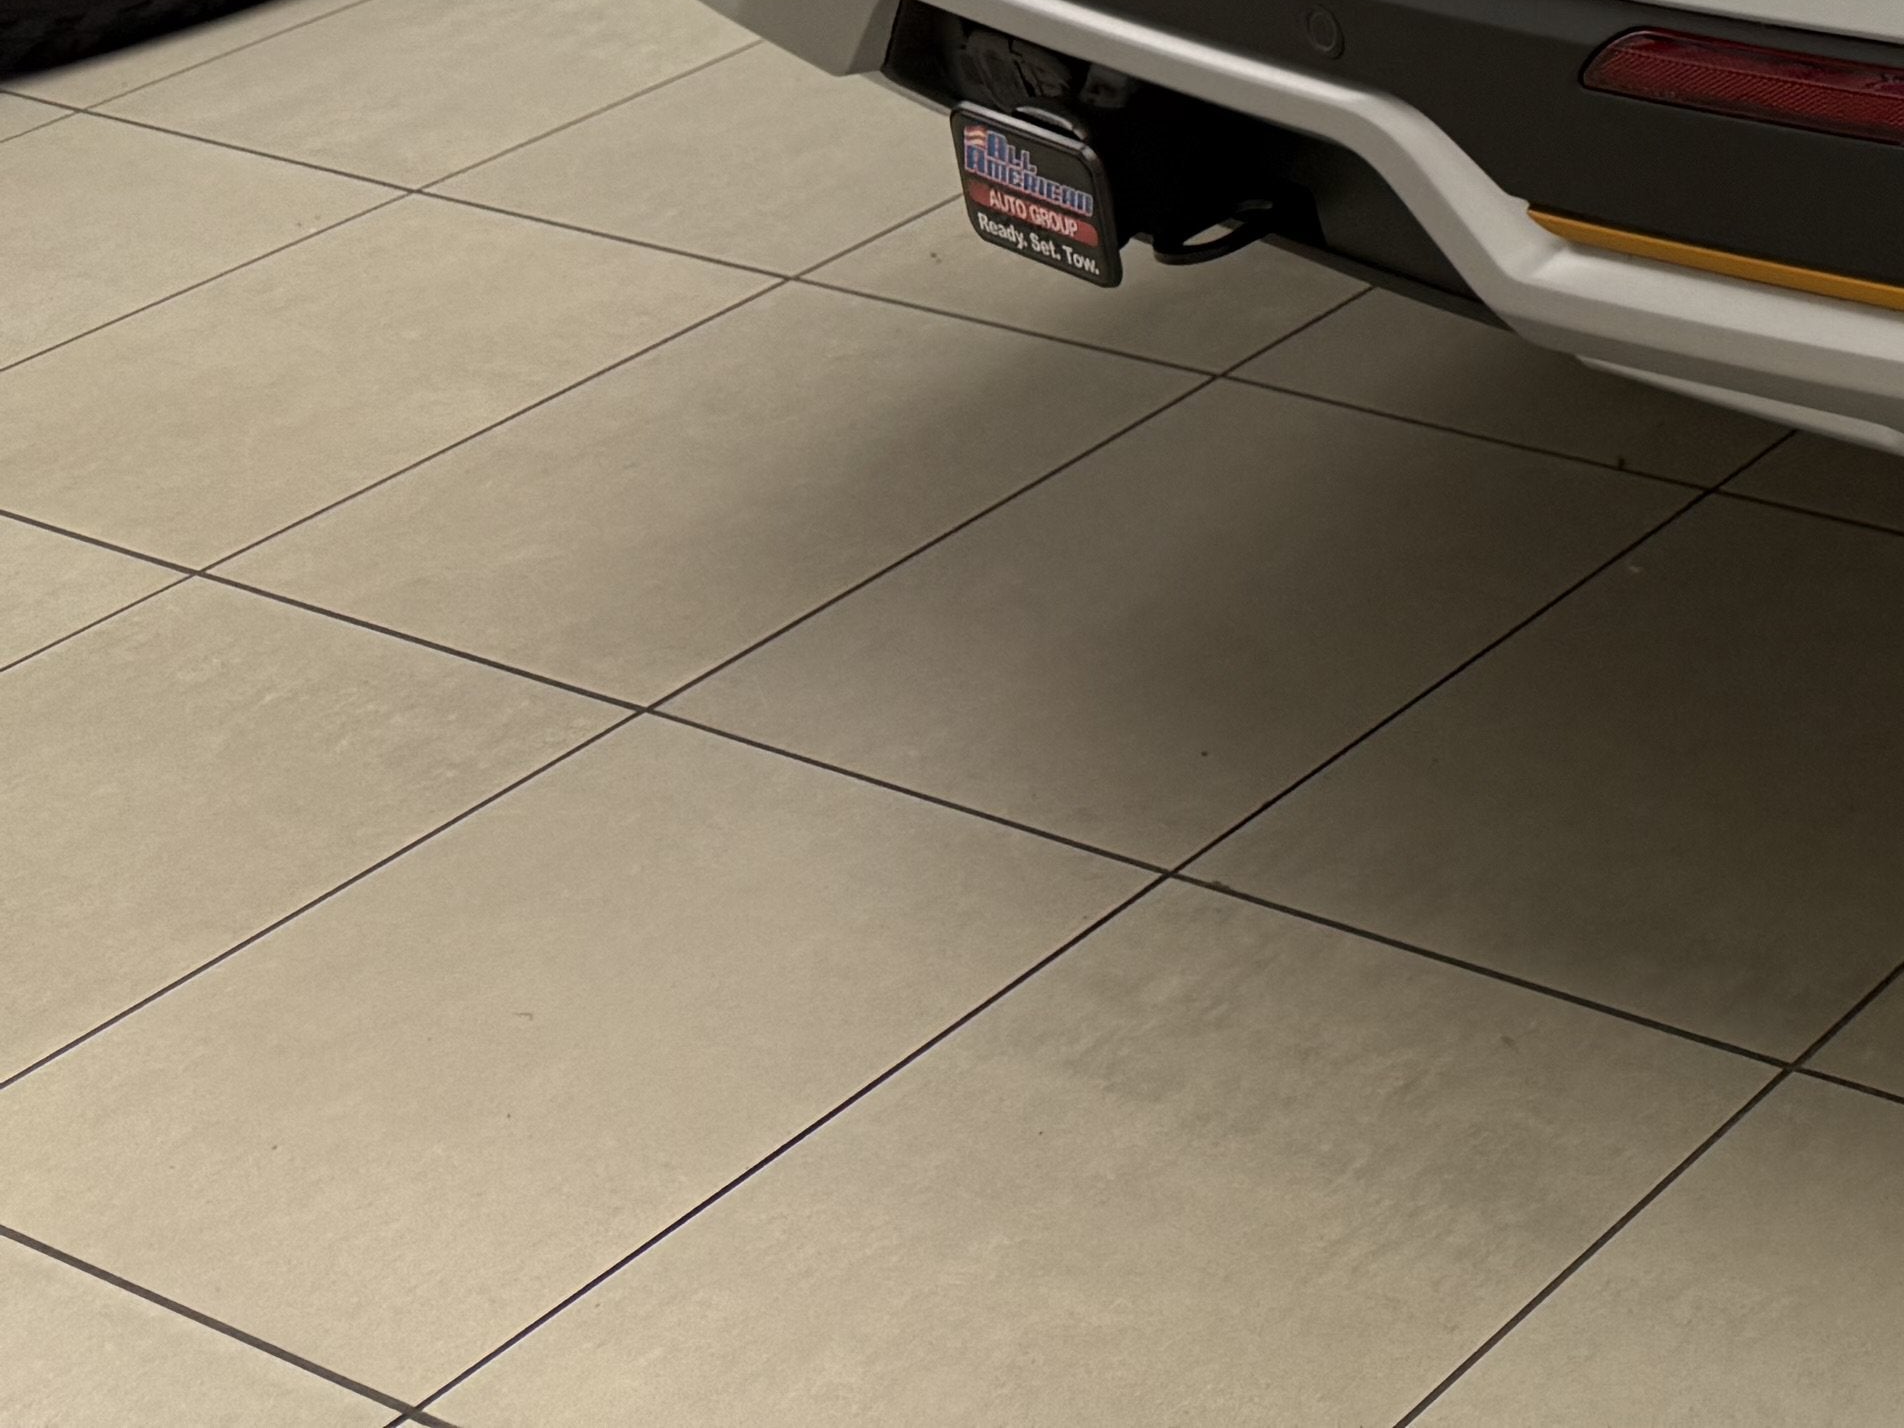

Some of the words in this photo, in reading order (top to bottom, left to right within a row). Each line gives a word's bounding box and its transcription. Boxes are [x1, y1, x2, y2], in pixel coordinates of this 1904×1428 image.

[989, 189, 1027, 219] AUTO
[1030, 205, 1078, 238] GROUP
[977, 211, 1028, 250] Ready.
[1029, 232, 1062, 260] Set.
[1061, 244, 1100, 276] Tow.
